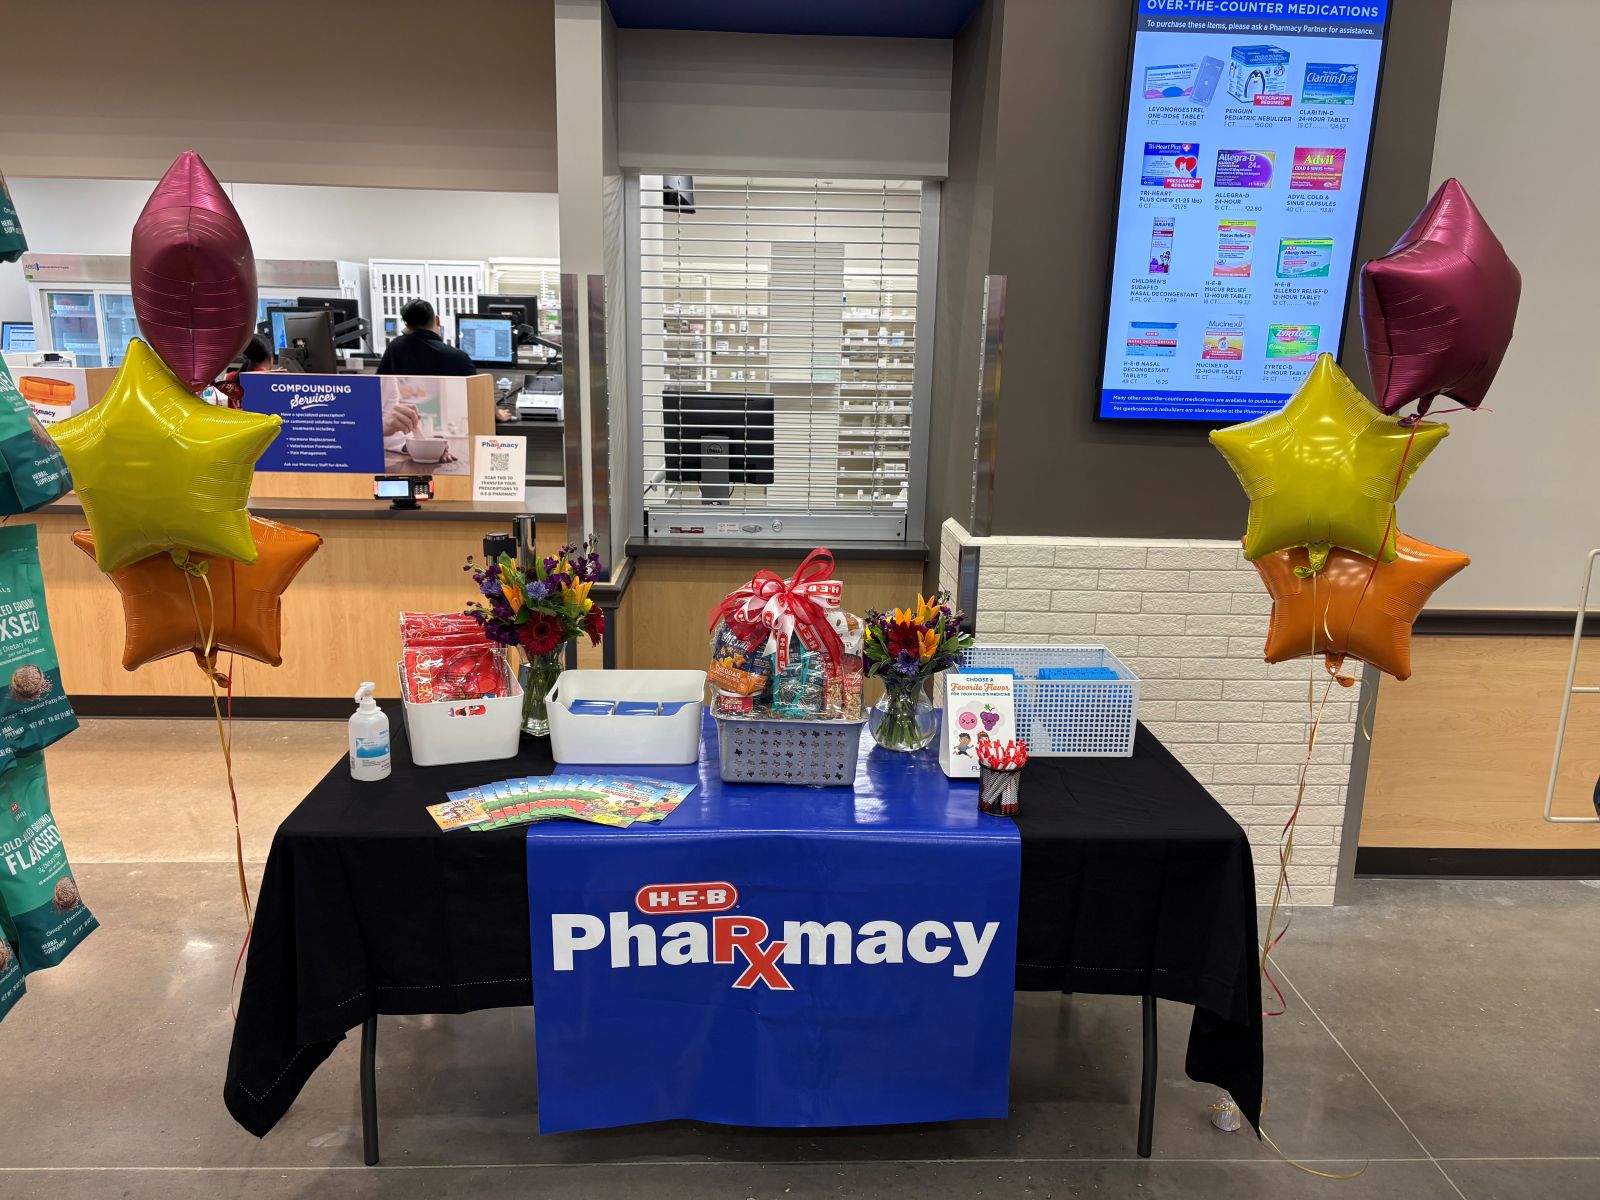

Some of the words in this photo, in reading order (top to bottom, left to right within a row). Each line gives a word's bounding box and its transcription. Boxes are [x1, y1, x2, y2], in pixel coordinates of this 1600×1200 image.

[1147, 0, 1283, 14] OVER-THE-COUNTER
[1288, 4, 1379, 17] MEDICATIONS
[1147, 20, 1155, 28] To
[1156, 20, 1187, 29] purchase
[1188, 21, 1206, 29] these
[1228, 23, 1250, 31] please
[1269, 24, 1302, 33] Pharmacy
[1303, 25, 1328, 33] Partner
[1339, 26, 1375, 35] assistance.
[1218, 153, 1256, 163] Allegra-D
[1305, 154, 1334, 165] Advil
[271, 383, 351, 394] COMPOUNDING
[290, 393, 336, 409] Services
[950, 682, 983, 692] Favorite
[984, 683, 1010, 692] Flavor
[23, 701, 45, 714] Essential
[724, 703, 743, 711] BEAN
[648, 888, 728, 907] H-E-B
